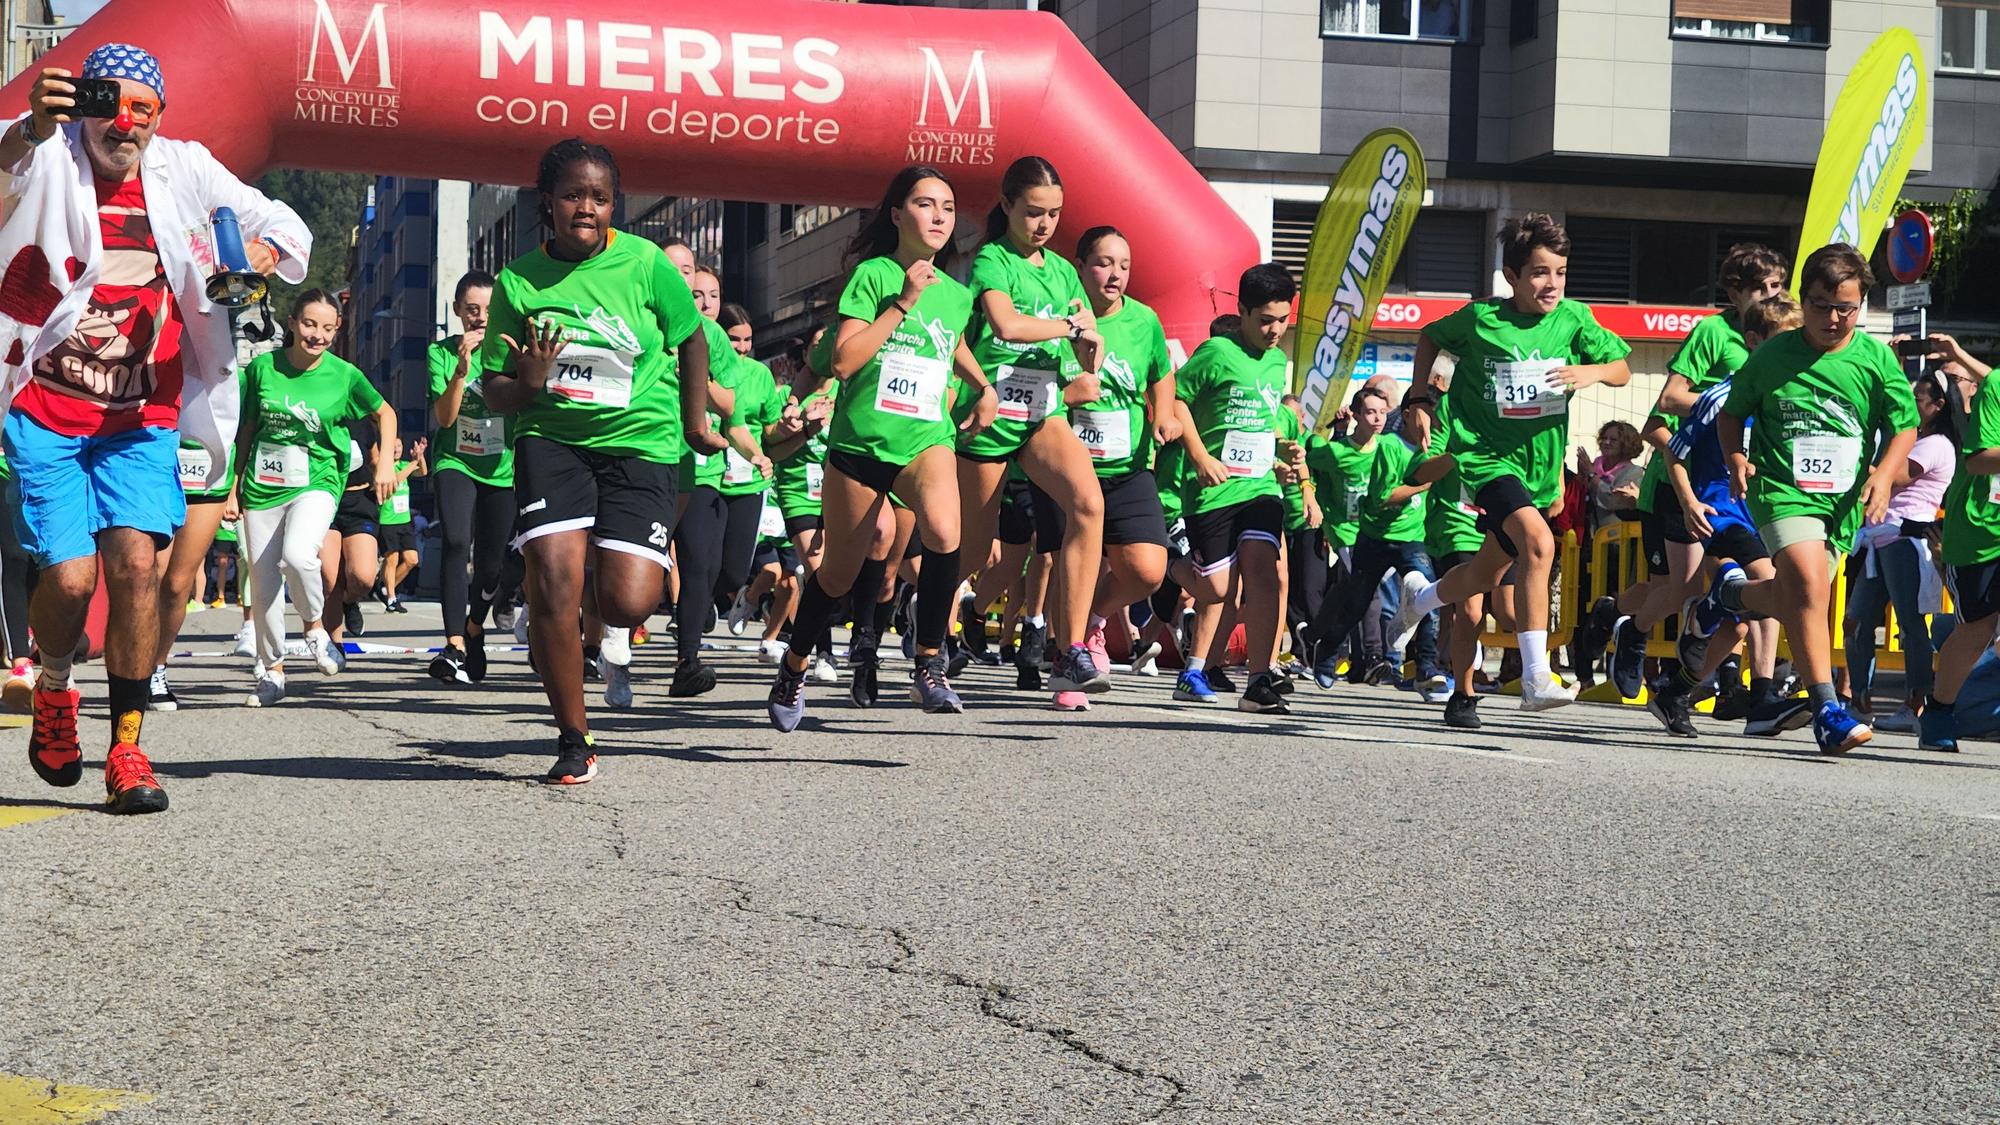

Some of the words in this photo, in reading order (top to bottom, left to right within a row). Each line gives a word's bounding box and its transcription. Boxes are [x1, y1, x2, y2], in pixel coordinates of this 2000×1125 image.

[479, 10, 845, 104] MIERES
[915, 46, 994, 129] M
[295, 87, 374, 105] CONCEYU
[378, 94, 400, 109] DE
[294, 102, 399, 128] MIERES
[476, 95, 569, 127] con
[588, 95, 628, 131] el
[647, 99, 840, 145] deporte
[908, 131, 975, 145] CONCEYU
[978, 134, 997, 146] DE
[905, 144, 995, 165] MIERES
[1372, 175, 1415, 279] SUPERMERCADOS
[1301, 143, 1409, 431] masymas
[1377, 303, 1421, 323] SGO
[557, 363, 593, 382] 704
[887, 377, 917, 397] 401
[1003, 387, 1033, 404] 325
[1230, 386, 1244, 397] En
[1505, 384, 1538, 401] 319
[1226, 407, 1257, 417] contra
[1778, 400, 1795, 411] En
[1224, 415, 1234, 423] el
[1782, 411, 1821, 420] march
[462, 430, 482, 443] 344
[1079, 428, 1104, 443] 406
[1782, 429, 1793, 438] el
[1229, 448, 1253, 462] 323
[180, 464, 205, 477] 345
[262, 459, 283, 473] 343
[1800, 458, 1832, 474] 352
[648, 521, 668, 548] 25
